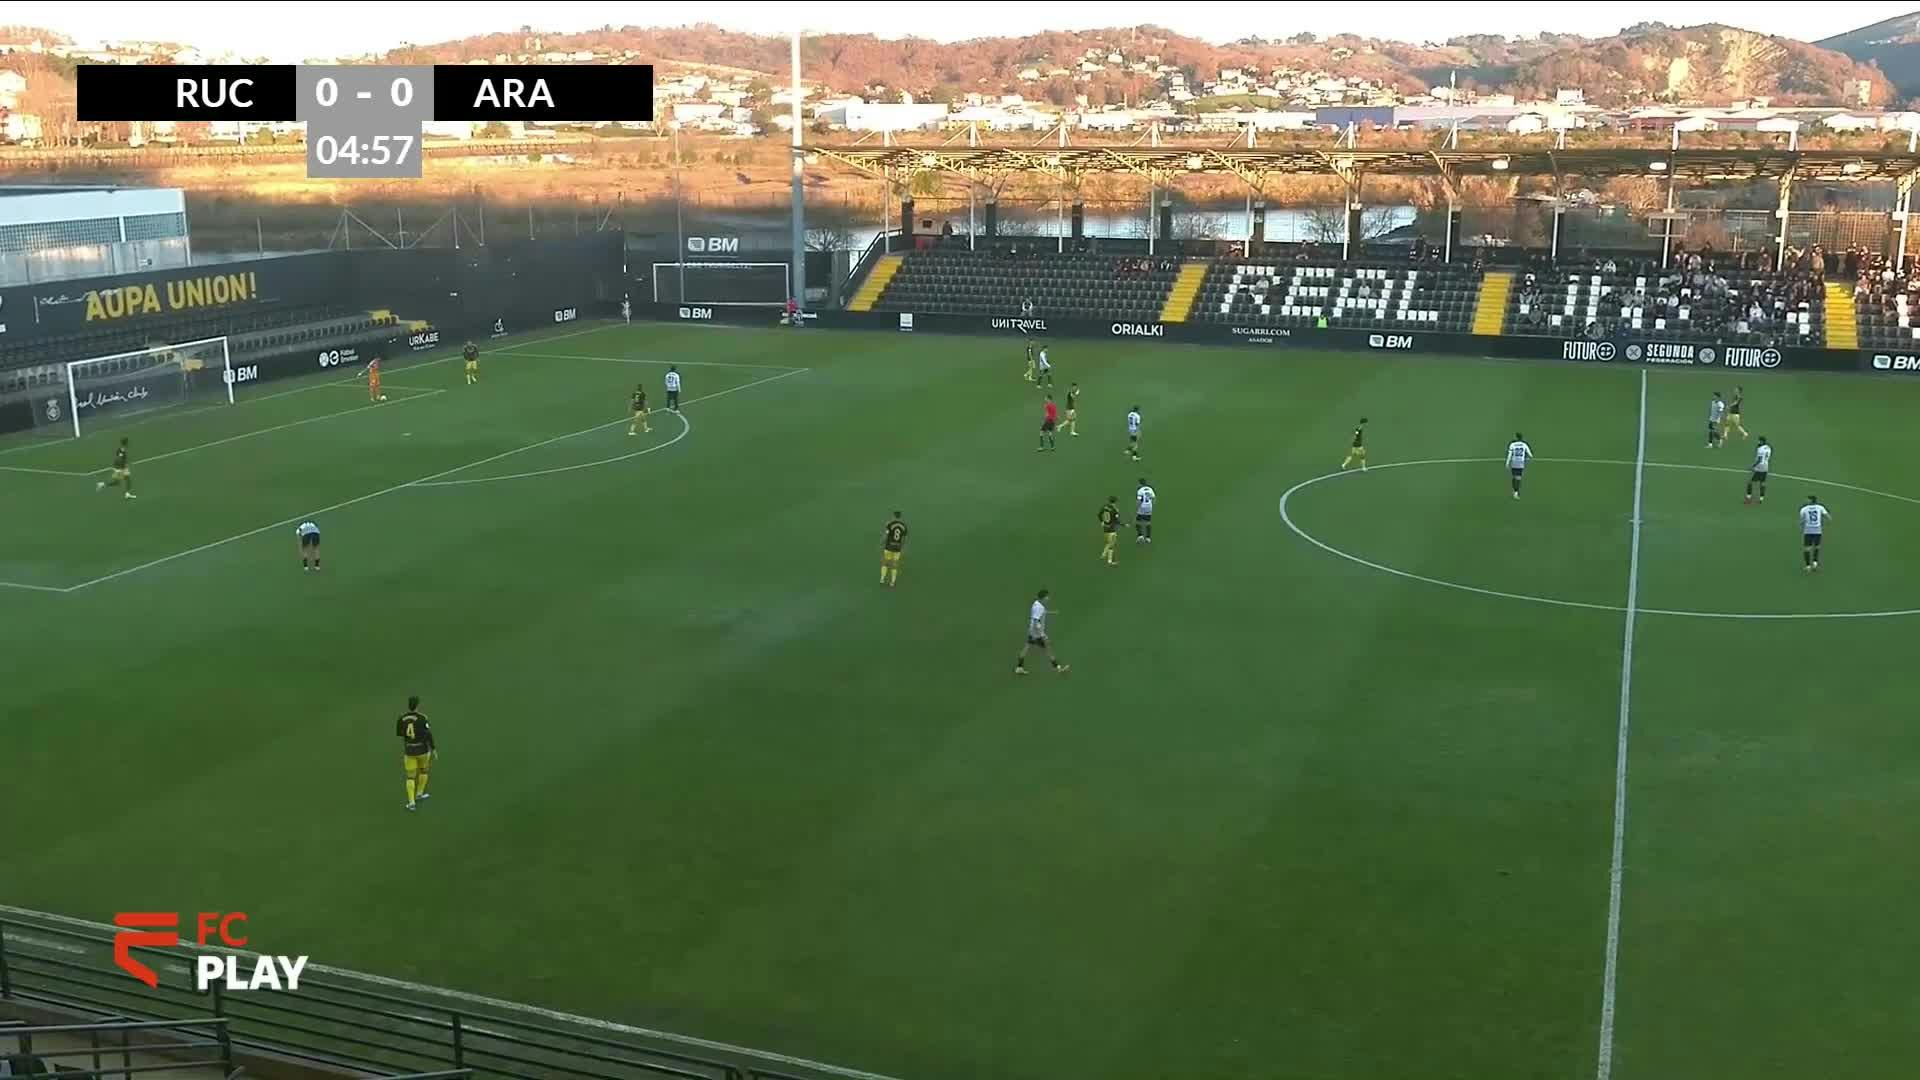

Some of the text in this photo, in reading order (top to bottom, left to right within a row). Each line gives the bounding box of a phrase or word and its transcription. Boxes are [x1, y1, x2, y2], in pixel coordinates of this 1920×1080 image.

[708, 237, 739, 252] BM
[86, 284, 161, 321] AUPA
[167, 272, 257, 310] UNION!
[564, 308, 577, 321] BM
[692, 308, 712, 319] BM
[991, 318, 1047, 334] UNITRAVEL
[1111, 323, 1164, 336] ORIALKI
[1386, 335, 1413, 348] BM
[1646, 343, 1694, 358] SEGUNDA
[1893, 355, 1920, 370] BM
[237, 366, 257, 382] BM
[406, 722, 415, 739] 4
